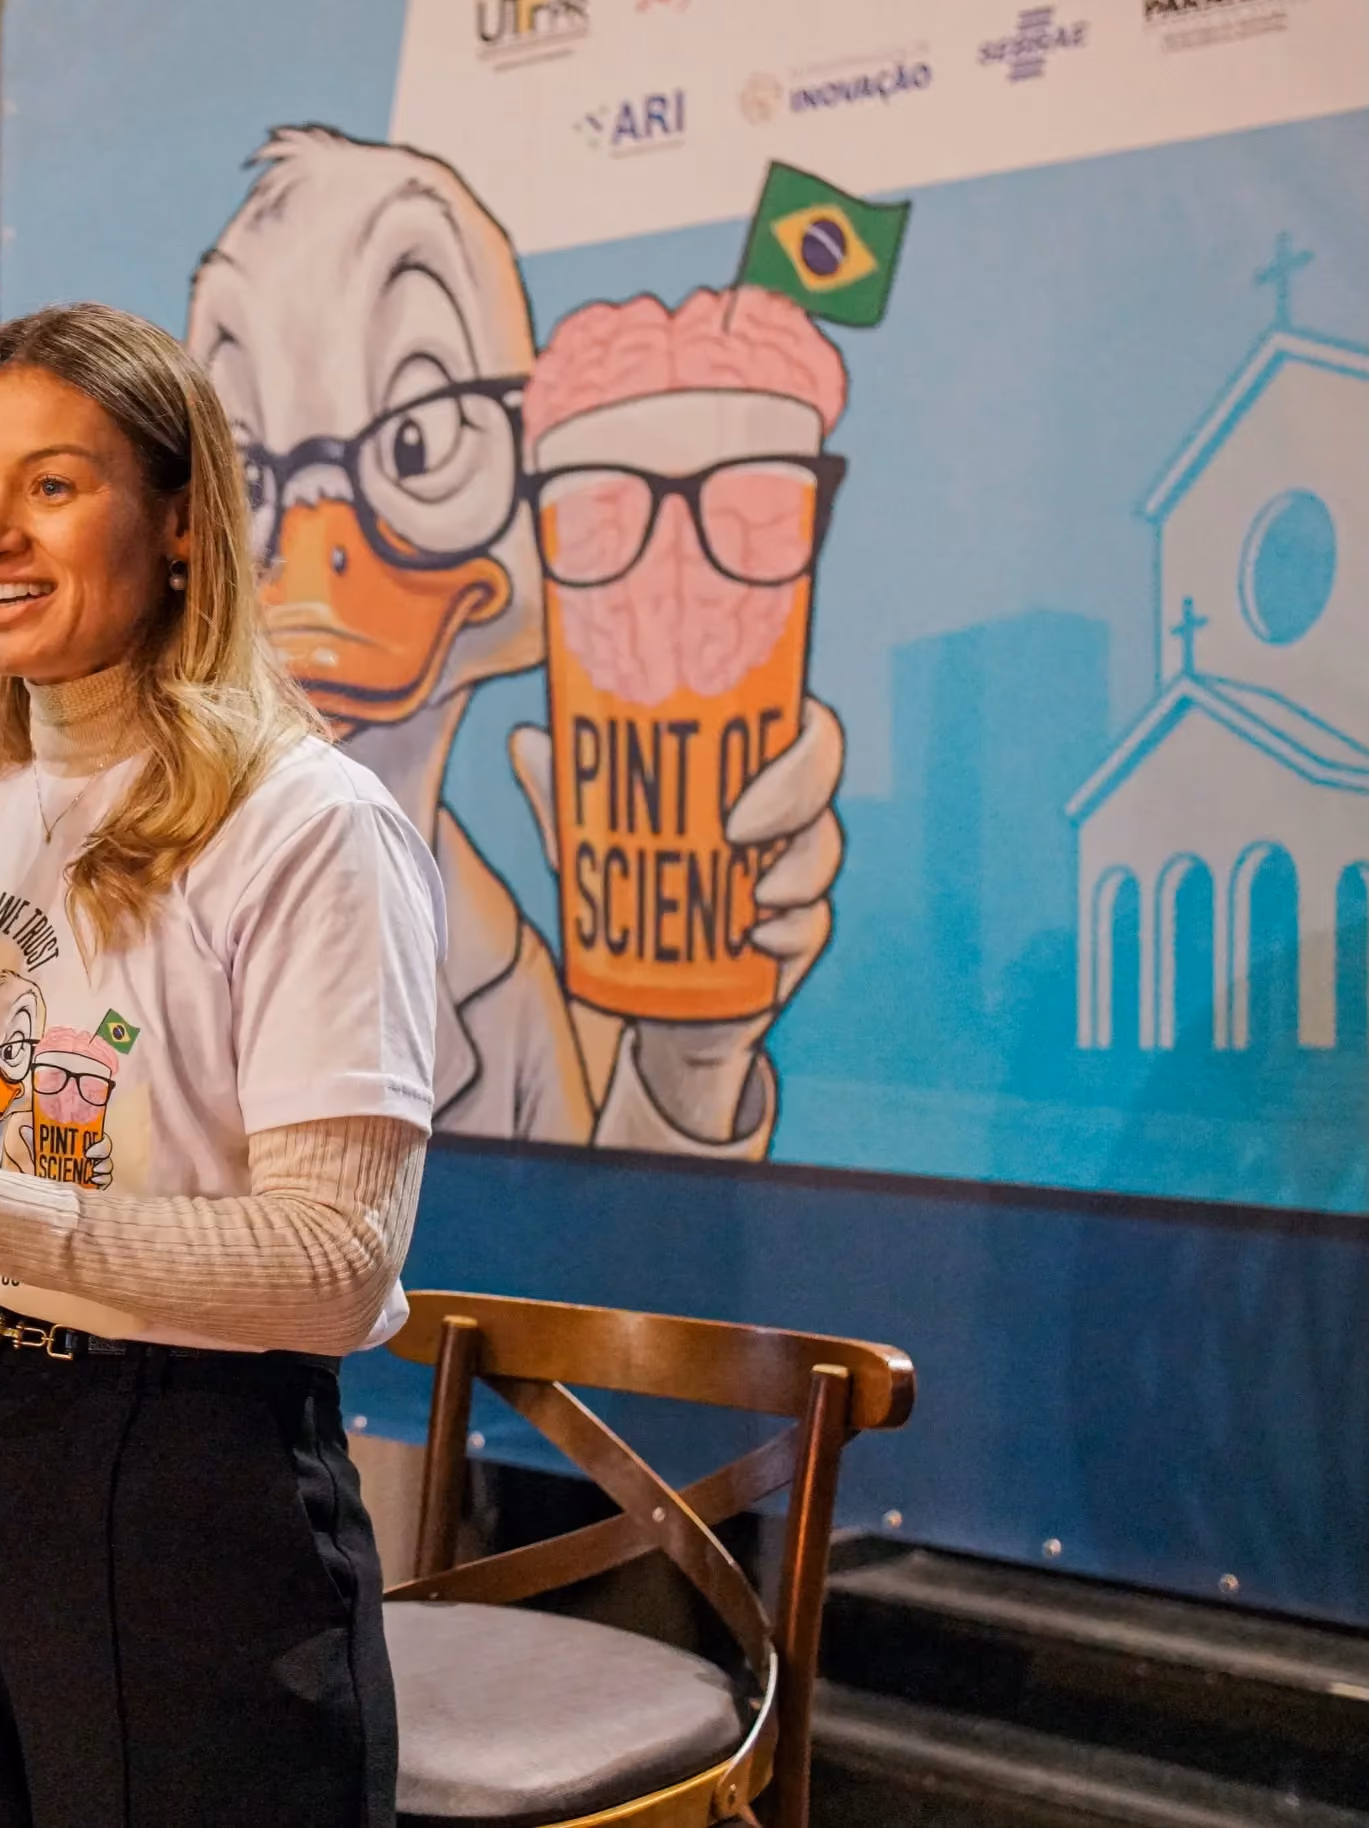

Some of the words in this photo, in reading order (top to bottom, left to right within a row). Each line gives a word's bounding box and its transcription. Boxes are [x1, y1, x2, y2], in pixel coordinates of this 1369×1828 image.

[611, 88, 685, 145] ARI
[572, 714, 701, 836] PINT
[574, 840, 766, 963] SCIENC
[11, 907, 60, 973] TRUST
[38, 1154, 97, 1185] SCIENC
[39, 1123, 79, 1156] PINT
